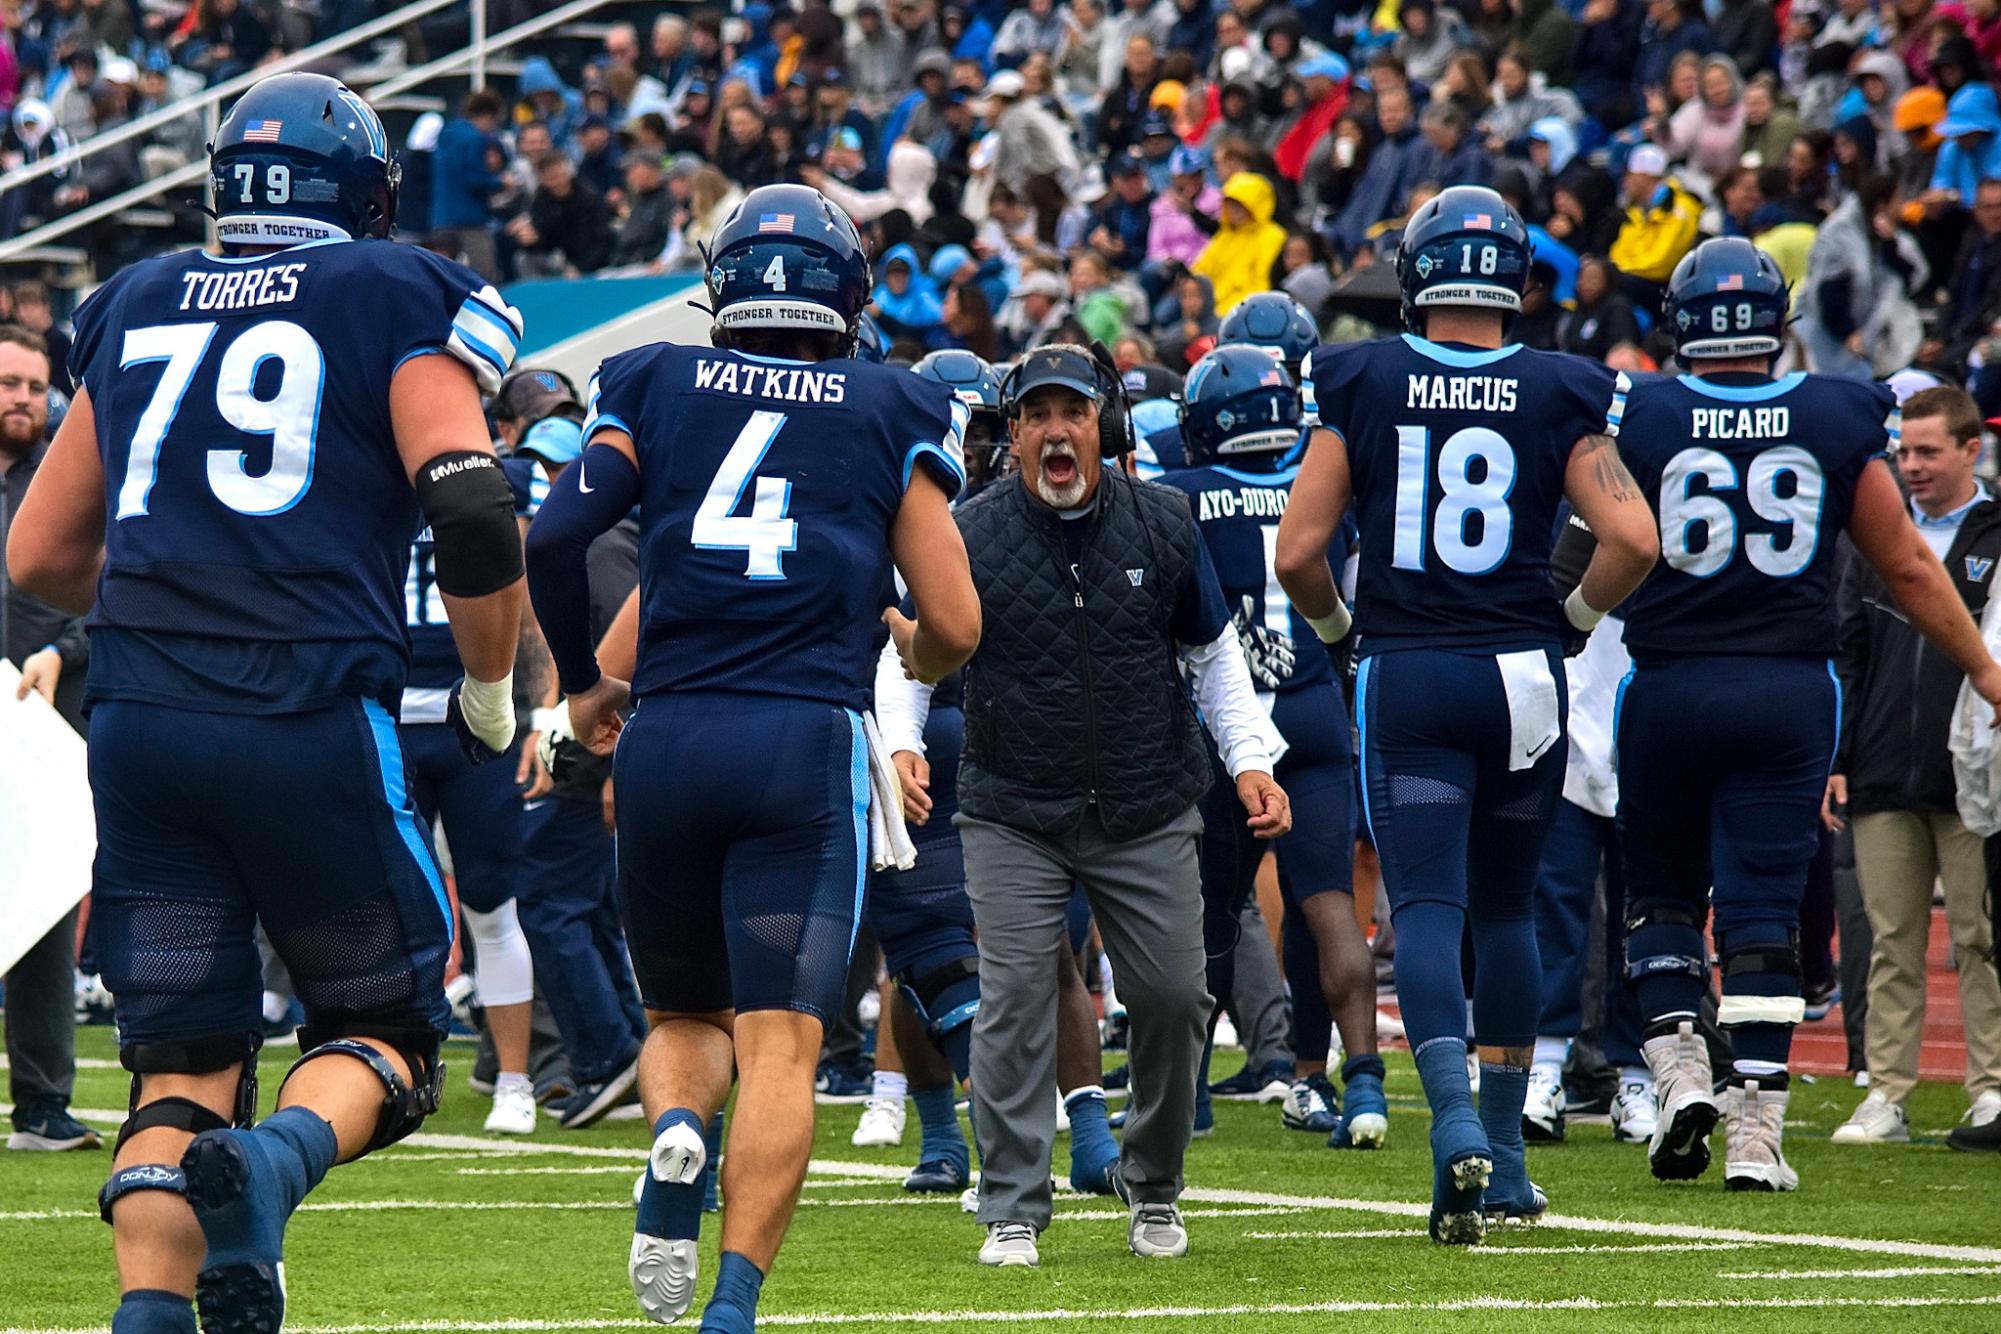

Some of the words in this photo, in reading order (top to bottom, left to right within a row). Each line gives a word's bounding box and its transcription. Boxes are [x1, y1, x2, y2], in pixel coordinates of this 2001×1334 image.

[234, 164, 290, 204] 79
[218, 224, 258, 236] STRONGER
[264, 224, 330, 239] TOGETHER
[763, 255, 787, 292] 4
[1460, 244, 1498, 275] 18
[179, 263, 307, 311] TORRES
[1425, 289, 1471, 302] STRONGER
[722, 308, 773, 325] STRONGER
[779, 308, 835, 326] TOGETHER
[1711, 303, 1752, 333] 69
[694, 359, 846, 403] WATKINS
[1407, 374, 1519, 412] MARCUS
[115, 320, 326, 523] 79
[1270, 397, 1280, 422] 1
[1691, 406, 1790, 440] PICARD
[690, 409, 799, 581] 4
[1390, 424, 1518, 576] 18
[1659, 445, 1827, 580] 69
